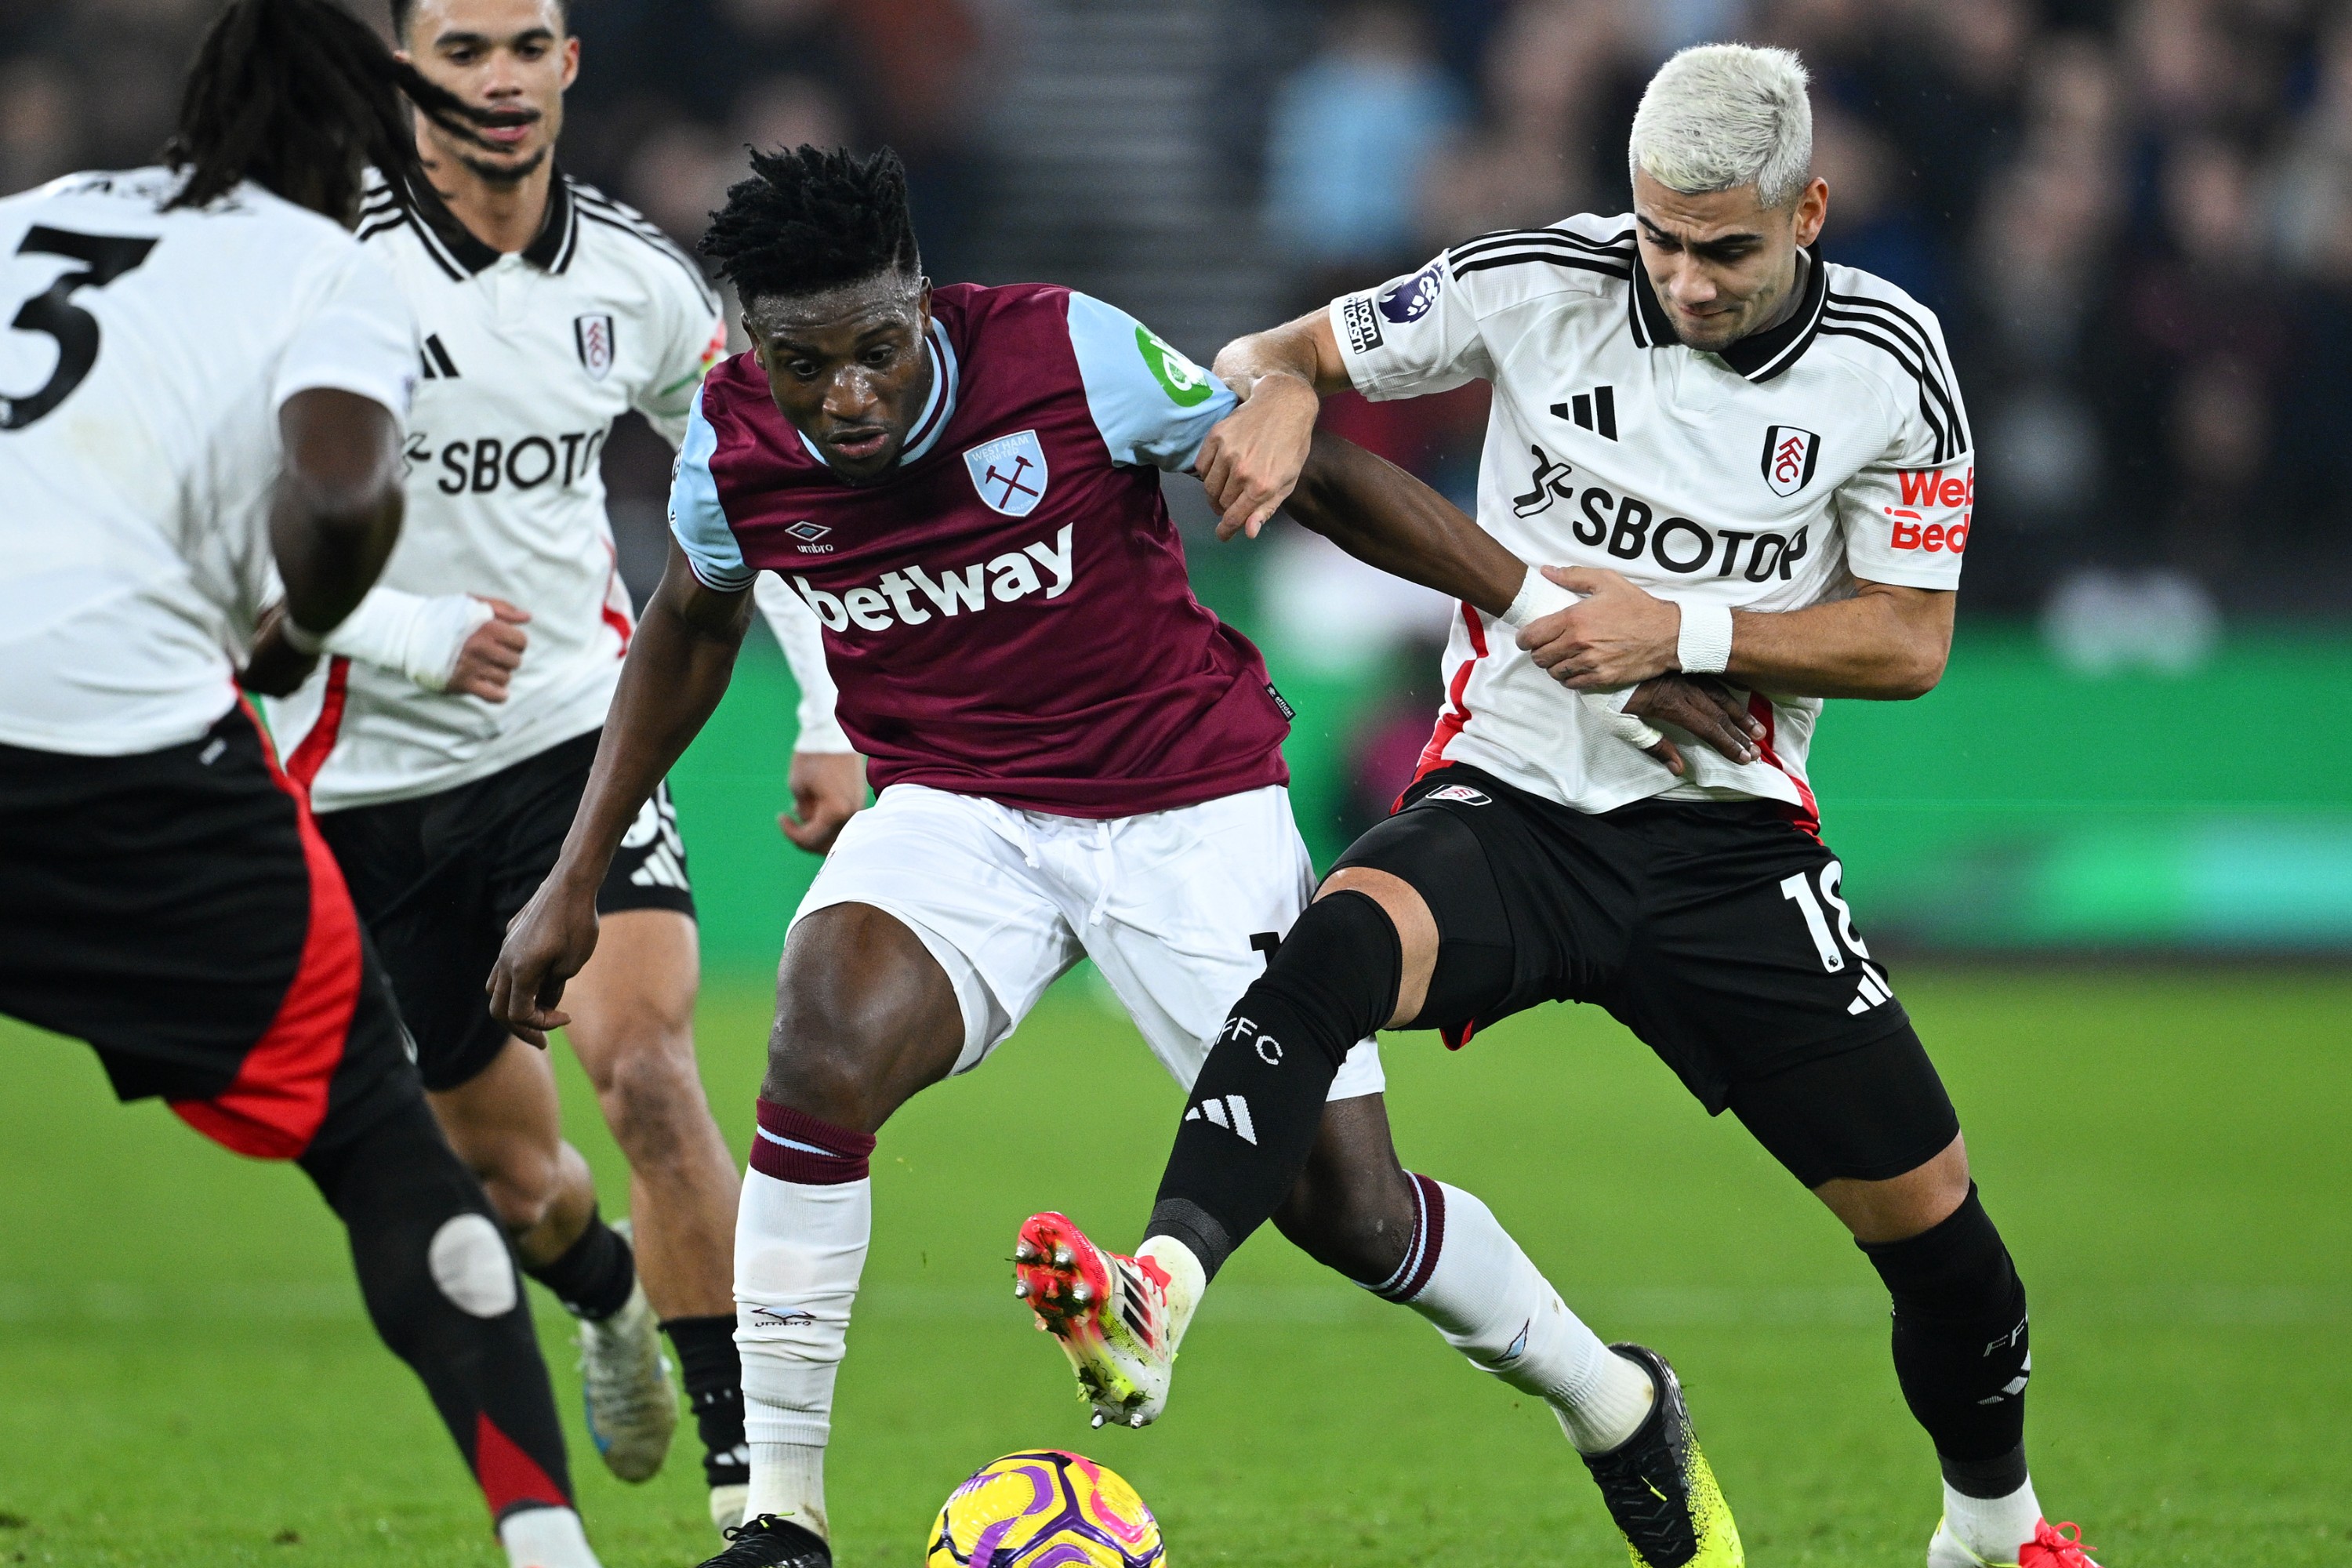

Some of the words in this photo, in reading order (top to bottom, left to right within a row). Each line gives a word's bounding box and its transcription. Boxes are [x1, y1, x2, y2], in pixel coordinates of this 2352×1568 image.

[0, 224, 161, 432] 3
[1344, 303, 1367, 354] racism
[1358, 299, 1378, 343] room
[972, 444, 1000, 462] WEST
[1002, 436, 1029, 451] HAM
[985, 447, 1019, 464] UNITED
[797, 543, 834, 554] umbro
[1572, 487, 1809, 583] SBOTOP
[793, 521, 1073, 632] betway
[1780, 860, 1870, 974] 18
[1216, 1017, 1283, 1066] FFC
